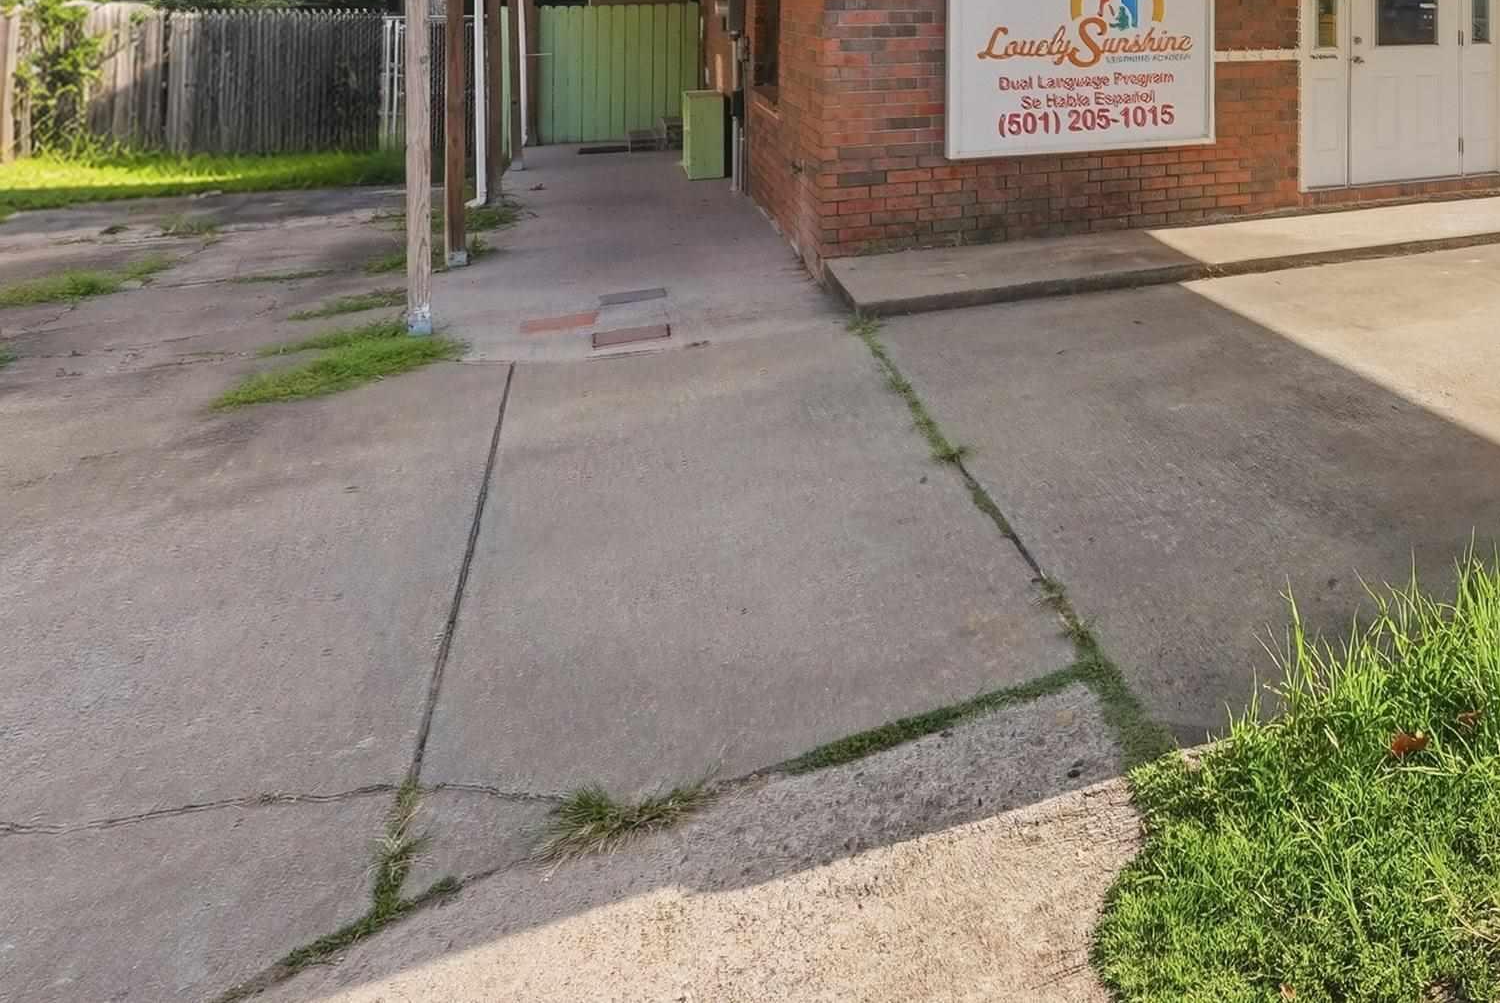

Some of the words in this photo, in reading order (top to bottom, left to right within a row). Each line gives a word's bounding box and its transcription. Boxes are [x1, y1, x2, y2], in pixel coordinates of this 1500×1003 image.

[977, 25, 1071, 65] Lovely
[1068, 16, 1192, 68] Sunshine
[998, 76, 1033, 91] Dual
[1037, 75, 1110, 92] Language
[1113, 72, 1174, 88] Program
[1021, 95, 1042, 110] Se
[1046, 92, 1090, 108] Habla
[1094, 90, 1156, 108] Español
[998, 110, 1061, 138] (501)
[1067, 104, 1175, 132] 205-1015
